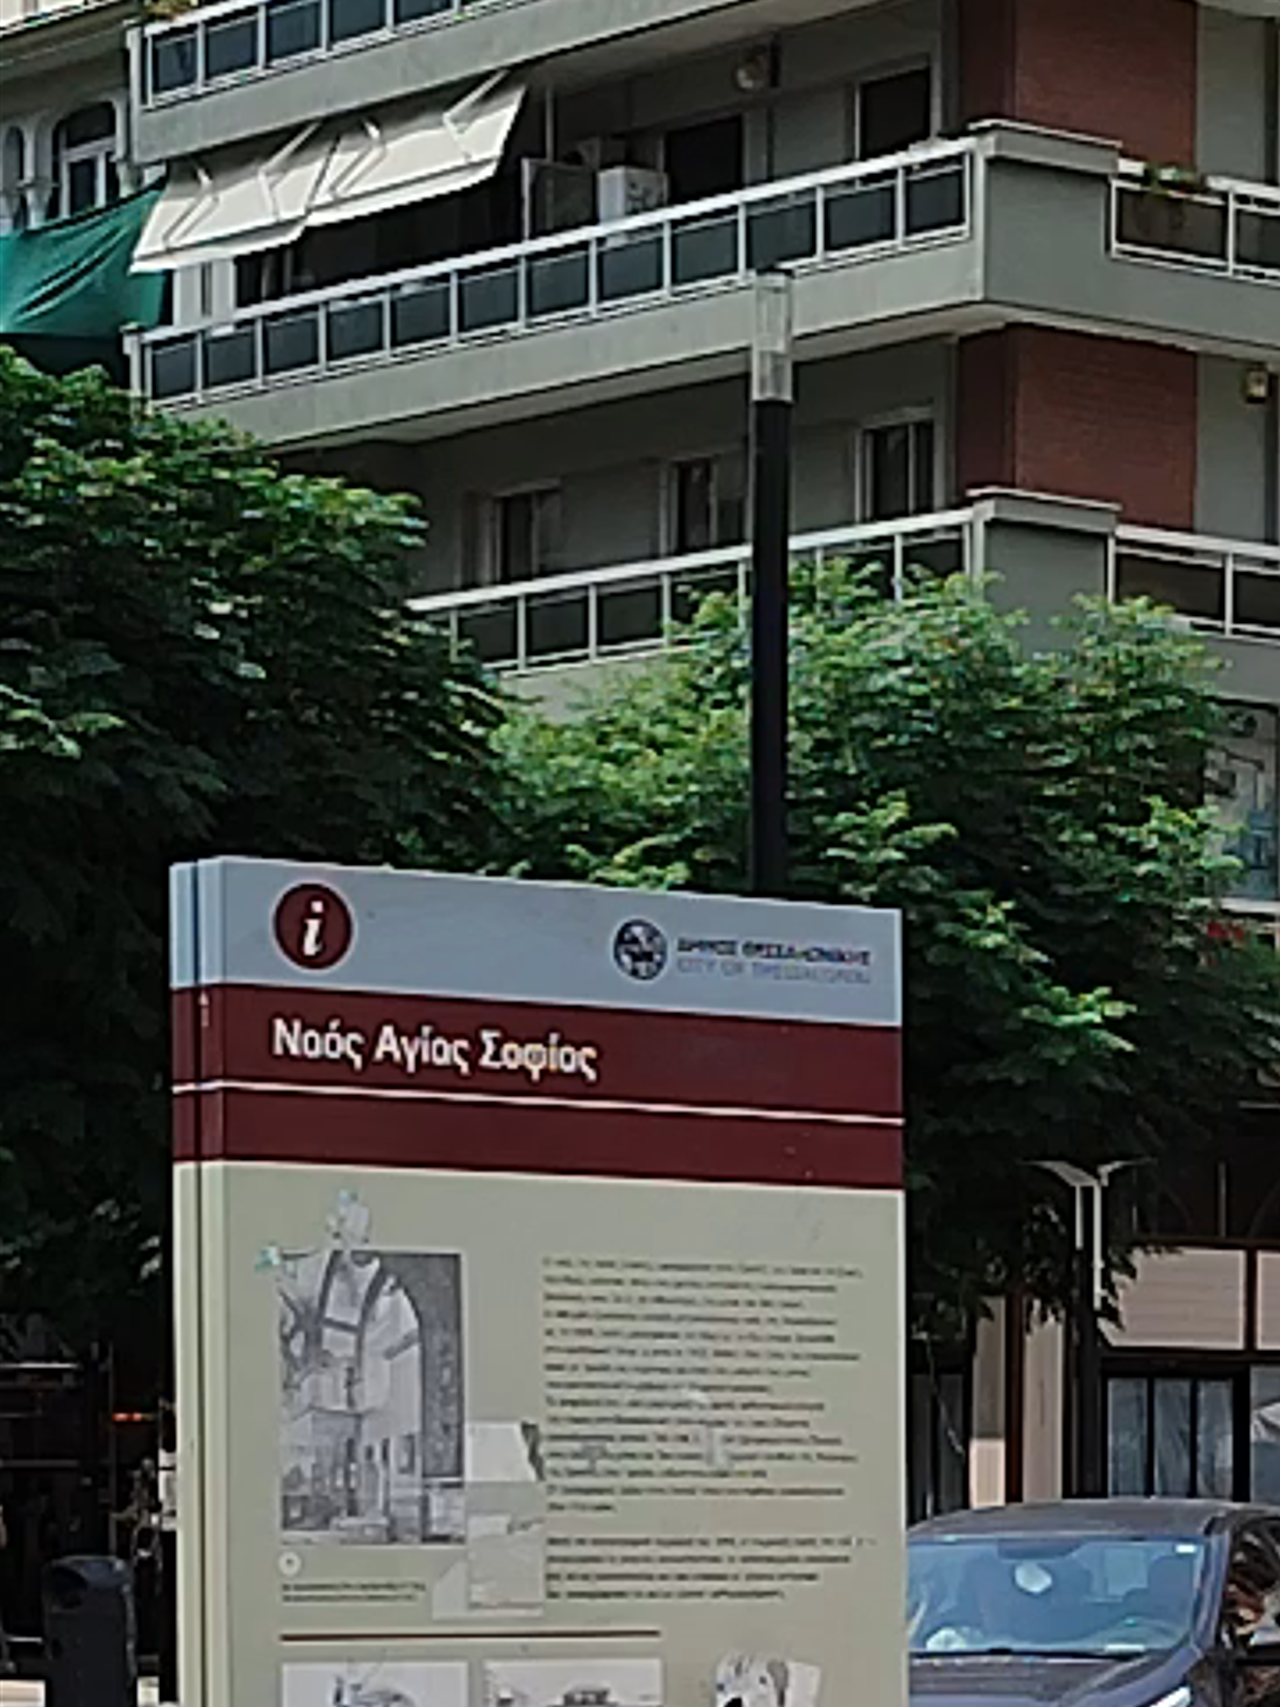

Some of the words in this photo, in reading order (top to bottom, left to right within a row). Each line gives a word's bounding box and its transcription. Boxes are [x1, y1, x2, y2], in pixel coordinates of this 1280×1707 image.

[272, 1018, 365, 1071] Ναός
[373, 1024, 471, 1075] Αγίας
[478, 1028, 598, 1082] Σοφίας
